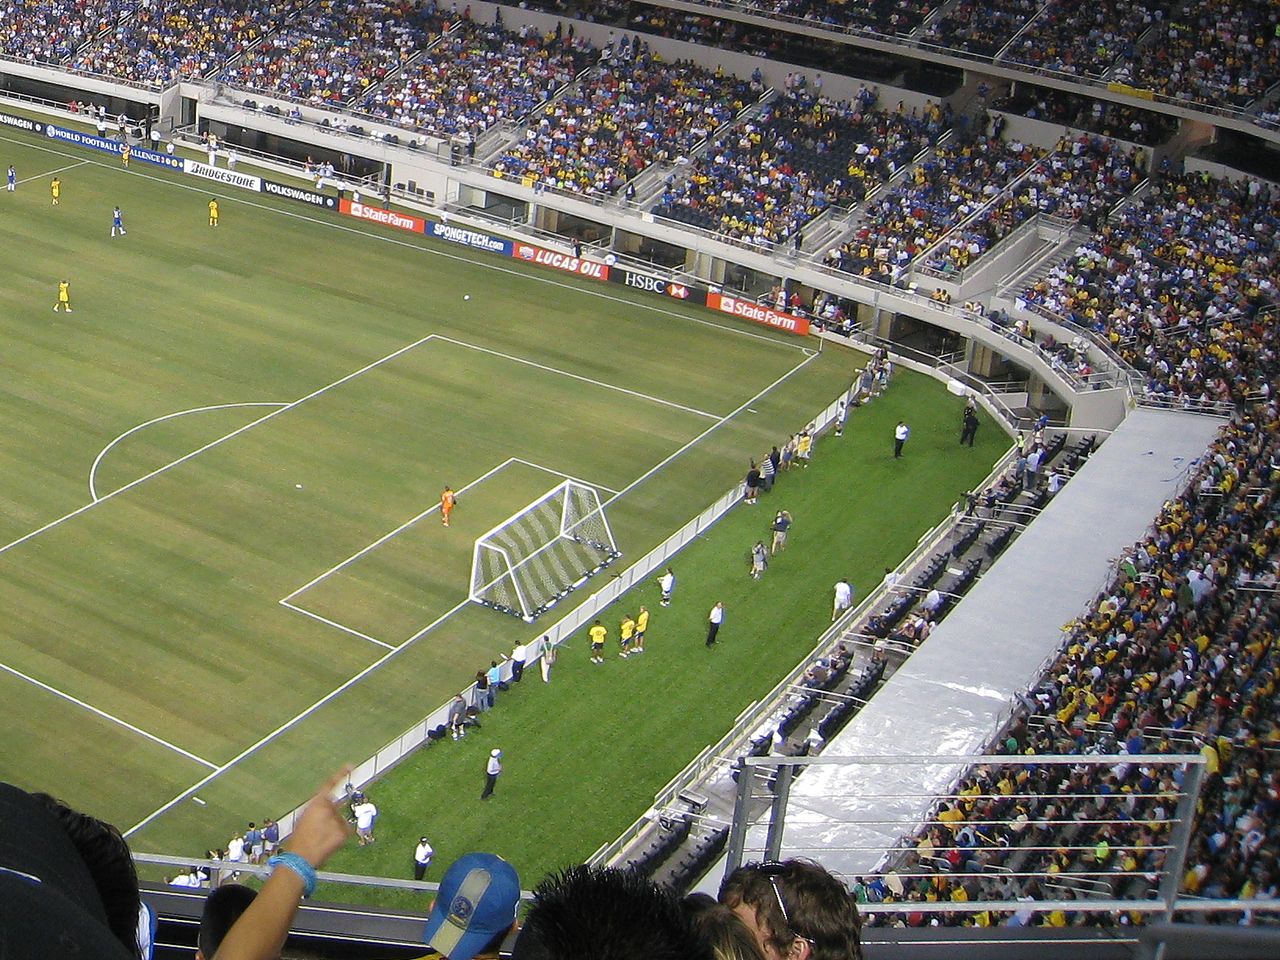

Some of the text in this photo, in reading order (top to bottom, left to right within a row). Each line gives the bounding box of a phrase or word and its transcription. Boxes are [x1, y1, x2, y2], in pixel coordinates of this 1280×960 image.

[55, 129, 81, 142] WORLD
[81, 136, 118, 152] FOOTBALL
[119, 143, 161, 163] CALLENGE
[190, 162, 256, 189] BRIDGESTONE
[266, 182, 323, 205] VOLKSWAGEN
[433, 223, 504, 251] SPONGETECH.com
[535, 250, 602, 278] LUCAS OIL
[625, 271, 665, 294] HSBC
